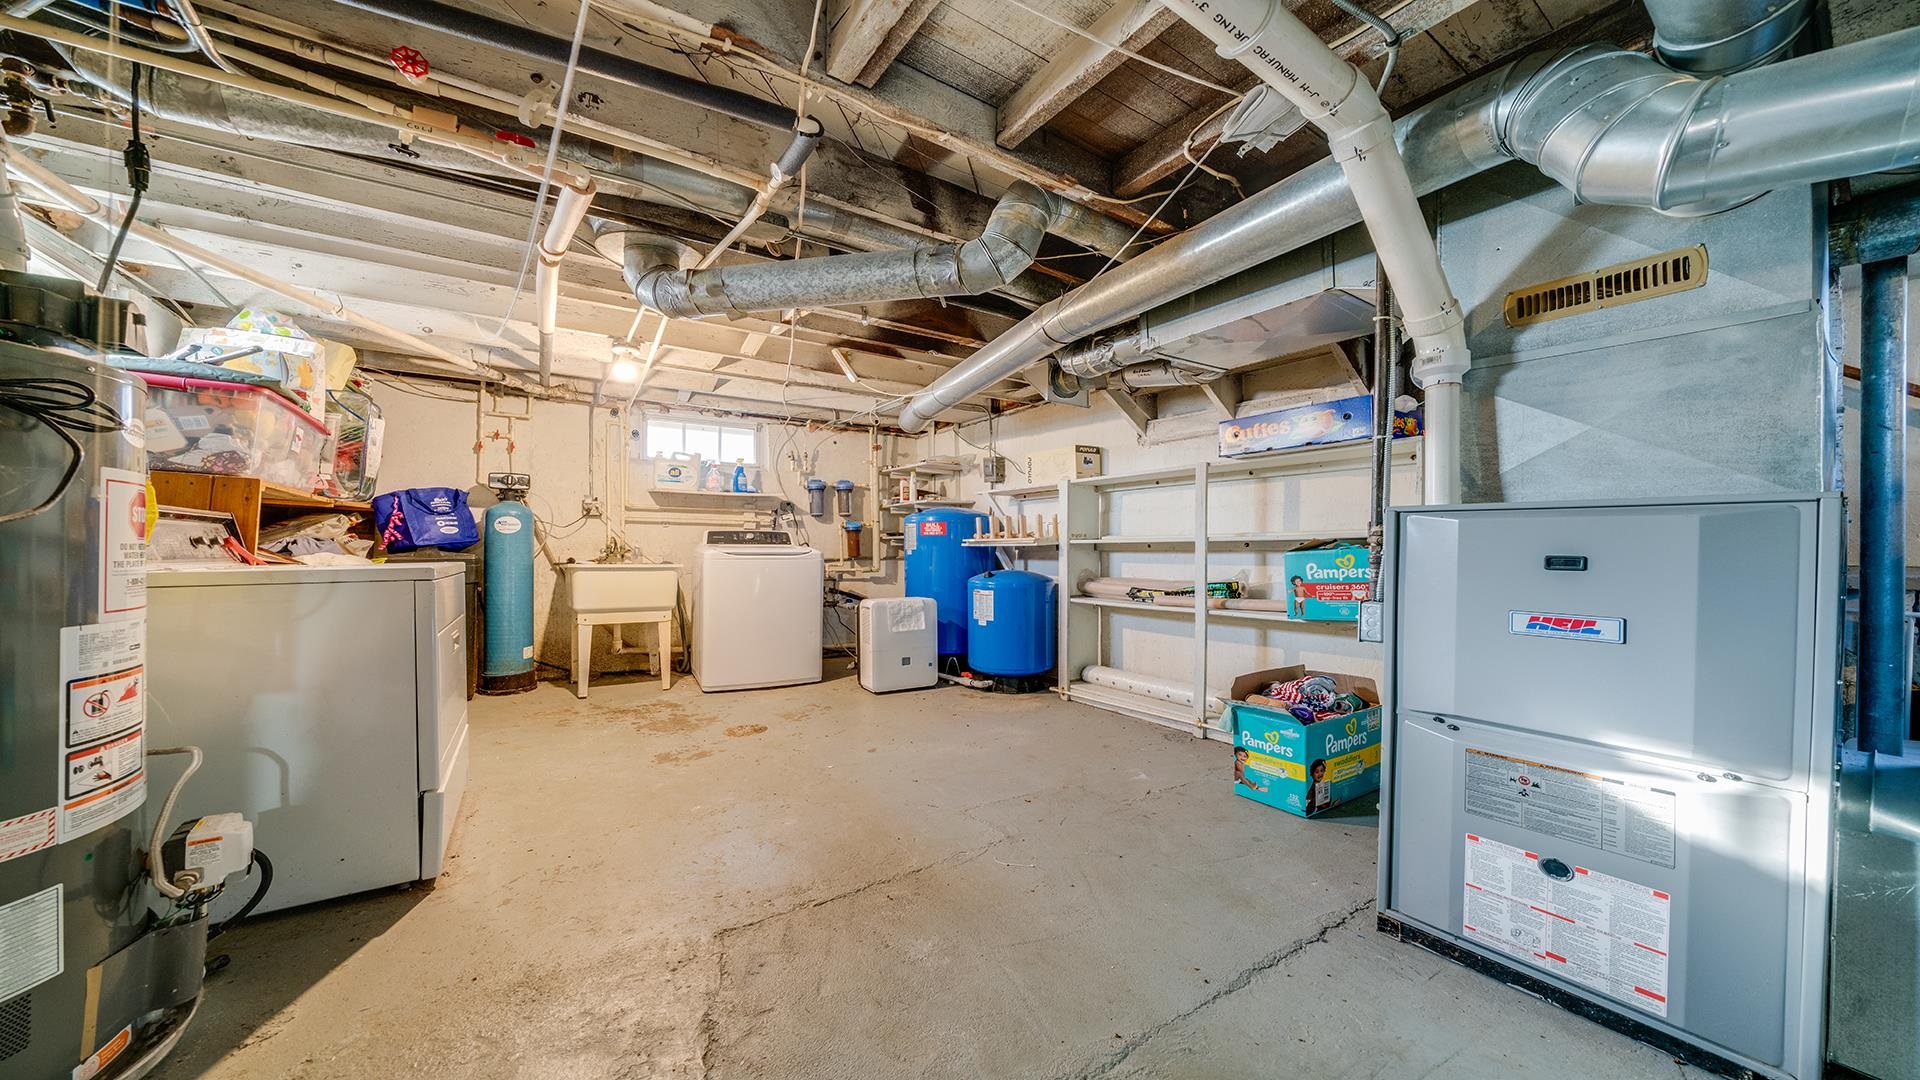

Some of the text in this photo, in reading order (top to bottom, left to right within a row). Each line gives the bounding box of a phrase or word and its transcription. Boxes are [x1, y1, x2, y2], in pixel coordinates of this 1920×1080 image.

[1306, 563, 1372, 581] Pampers
[1242, 730, 1293, 757] Pampers
[1325, 731, 1367, 756] Pampers
